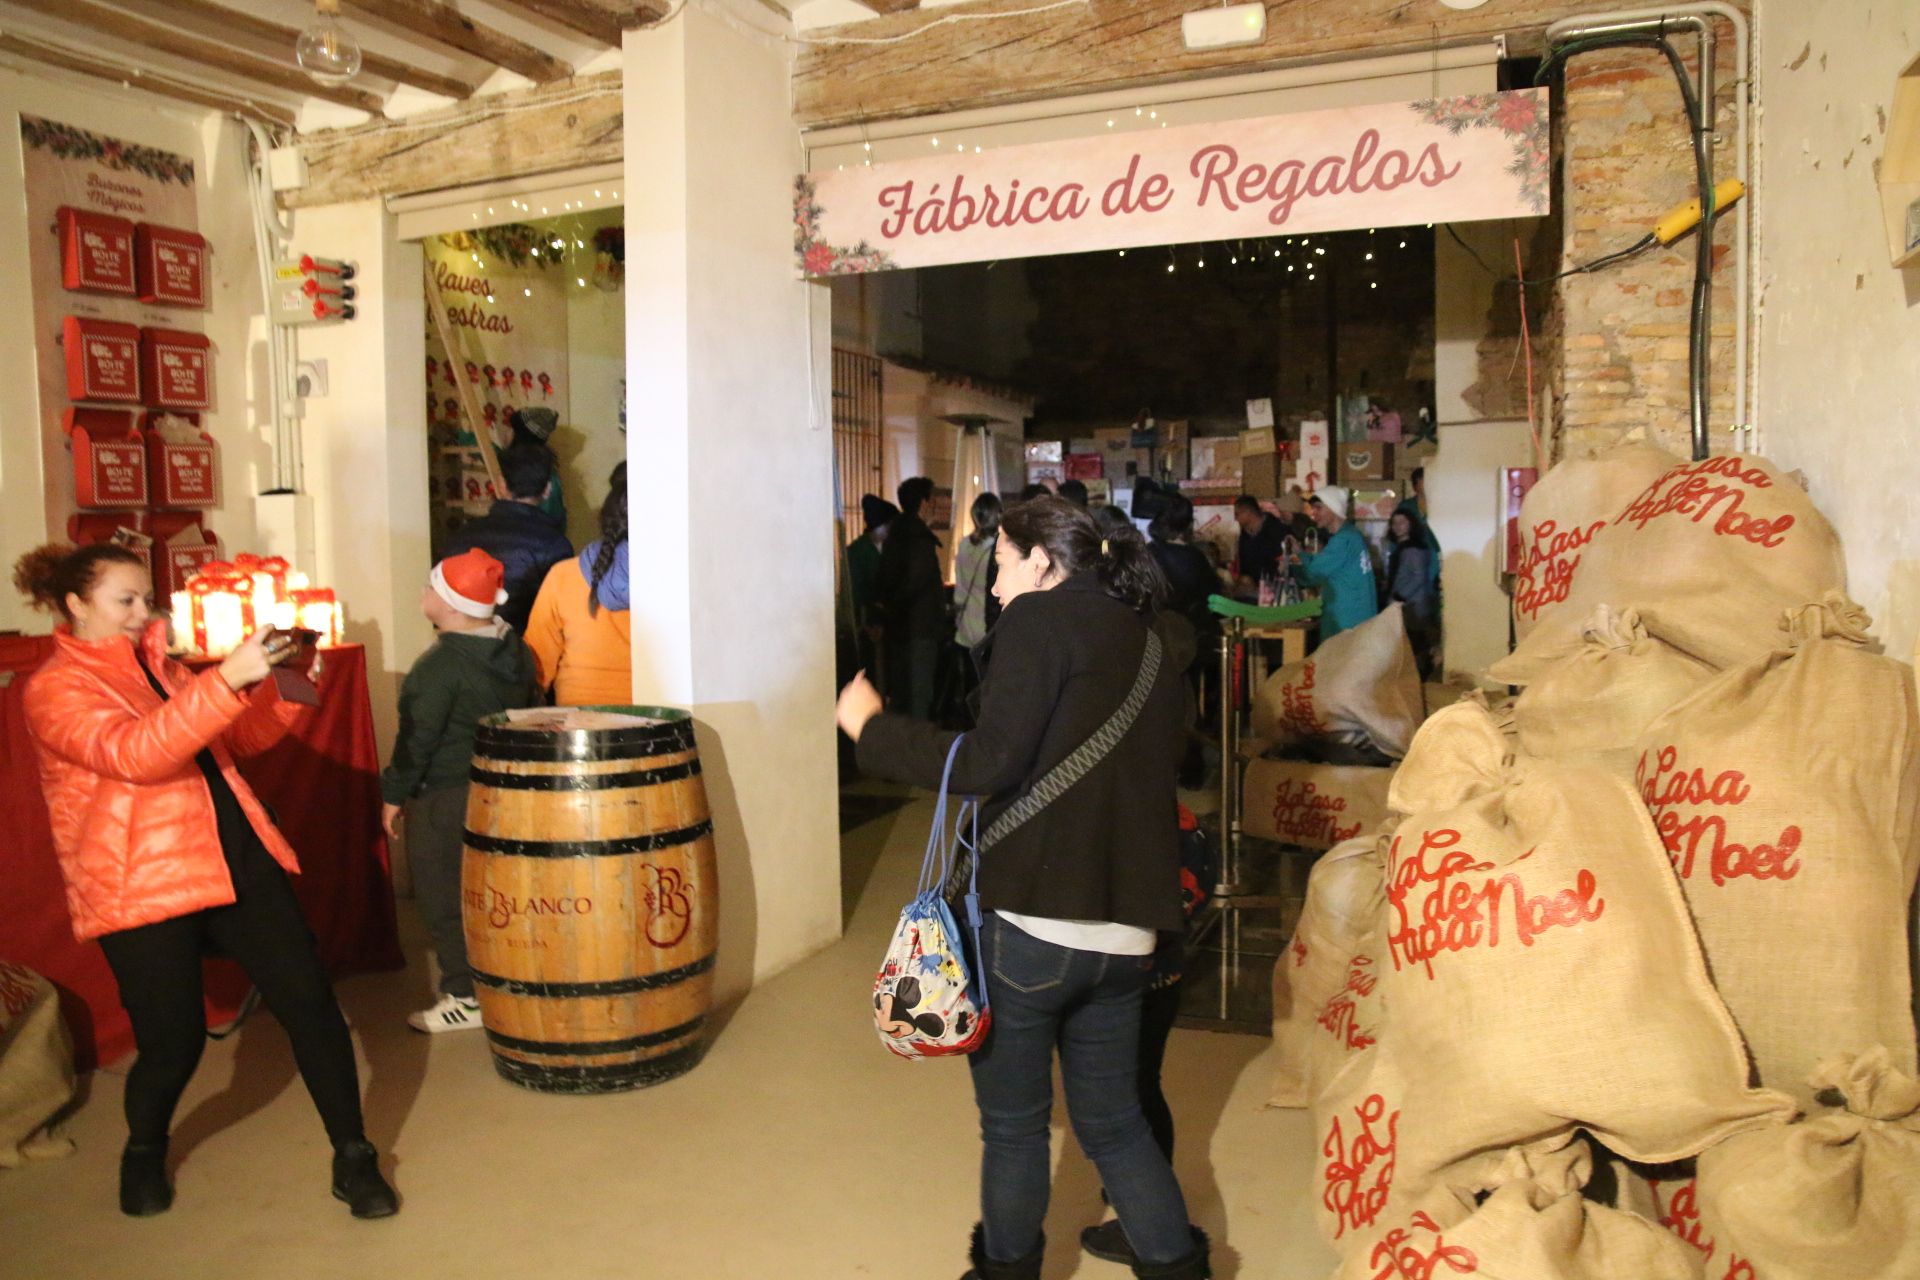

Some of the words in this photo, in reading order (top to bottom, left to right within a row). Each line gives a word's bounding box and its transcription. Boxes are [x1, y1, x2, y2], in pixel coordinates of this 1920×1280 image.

[878, 174, 1090, 239] Fábrica
[1100, 154, 1174, 217] de
[1190, 128, 1461, 226] Regalos
[431, 260, 495, 298] laves
[1691, 485, 1795, 548] Noel
[1656, 745, 1751, 806] Casa
[1679, 815, 1803, 887] Noel
[1476, 868, 1605, 947] Noel
